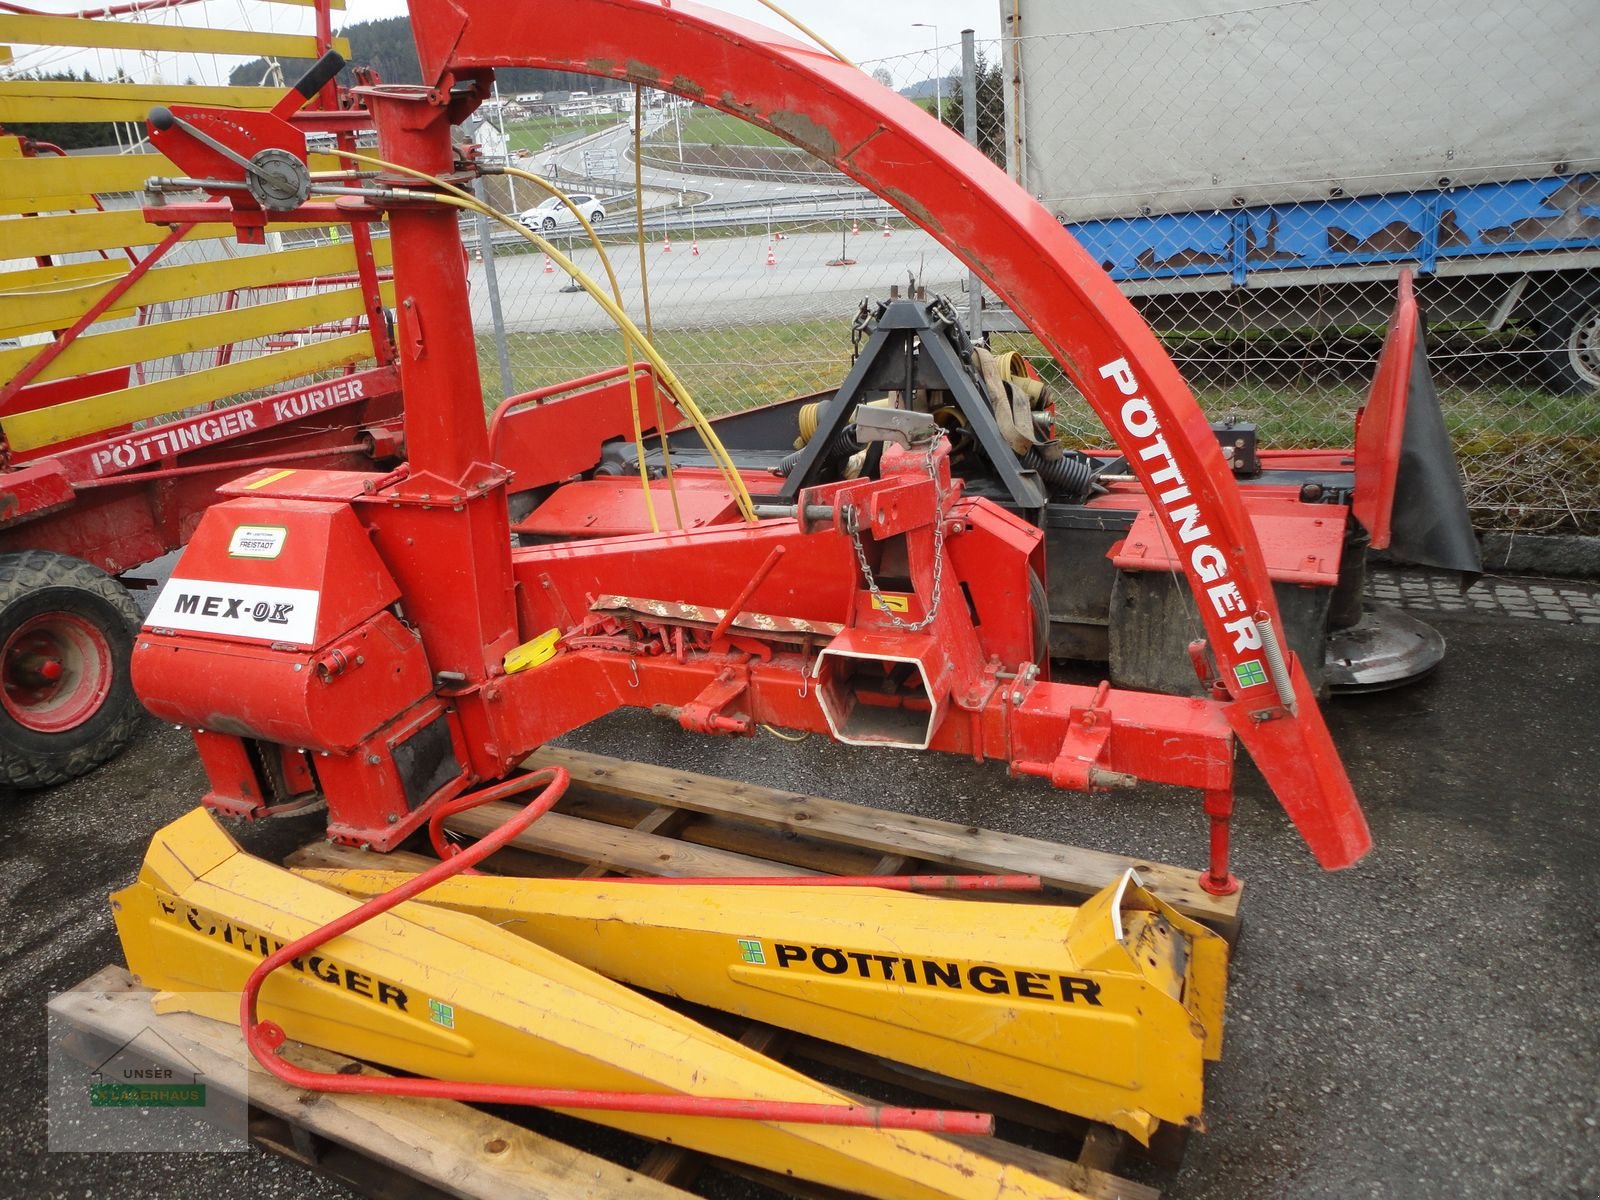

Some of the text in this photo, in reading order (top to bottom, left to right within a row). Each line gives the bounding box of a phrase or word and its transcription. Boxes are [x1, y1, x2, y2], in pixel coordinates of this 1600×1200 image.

[90, 378, 365, 474] PÖTTINGER KURIER
[239, 541, 274, 549] FREISTADT
[1097, 357, 1264, 655] PÖTTINGER
[774, 943, 1103, 1007] PÖTTINGER
